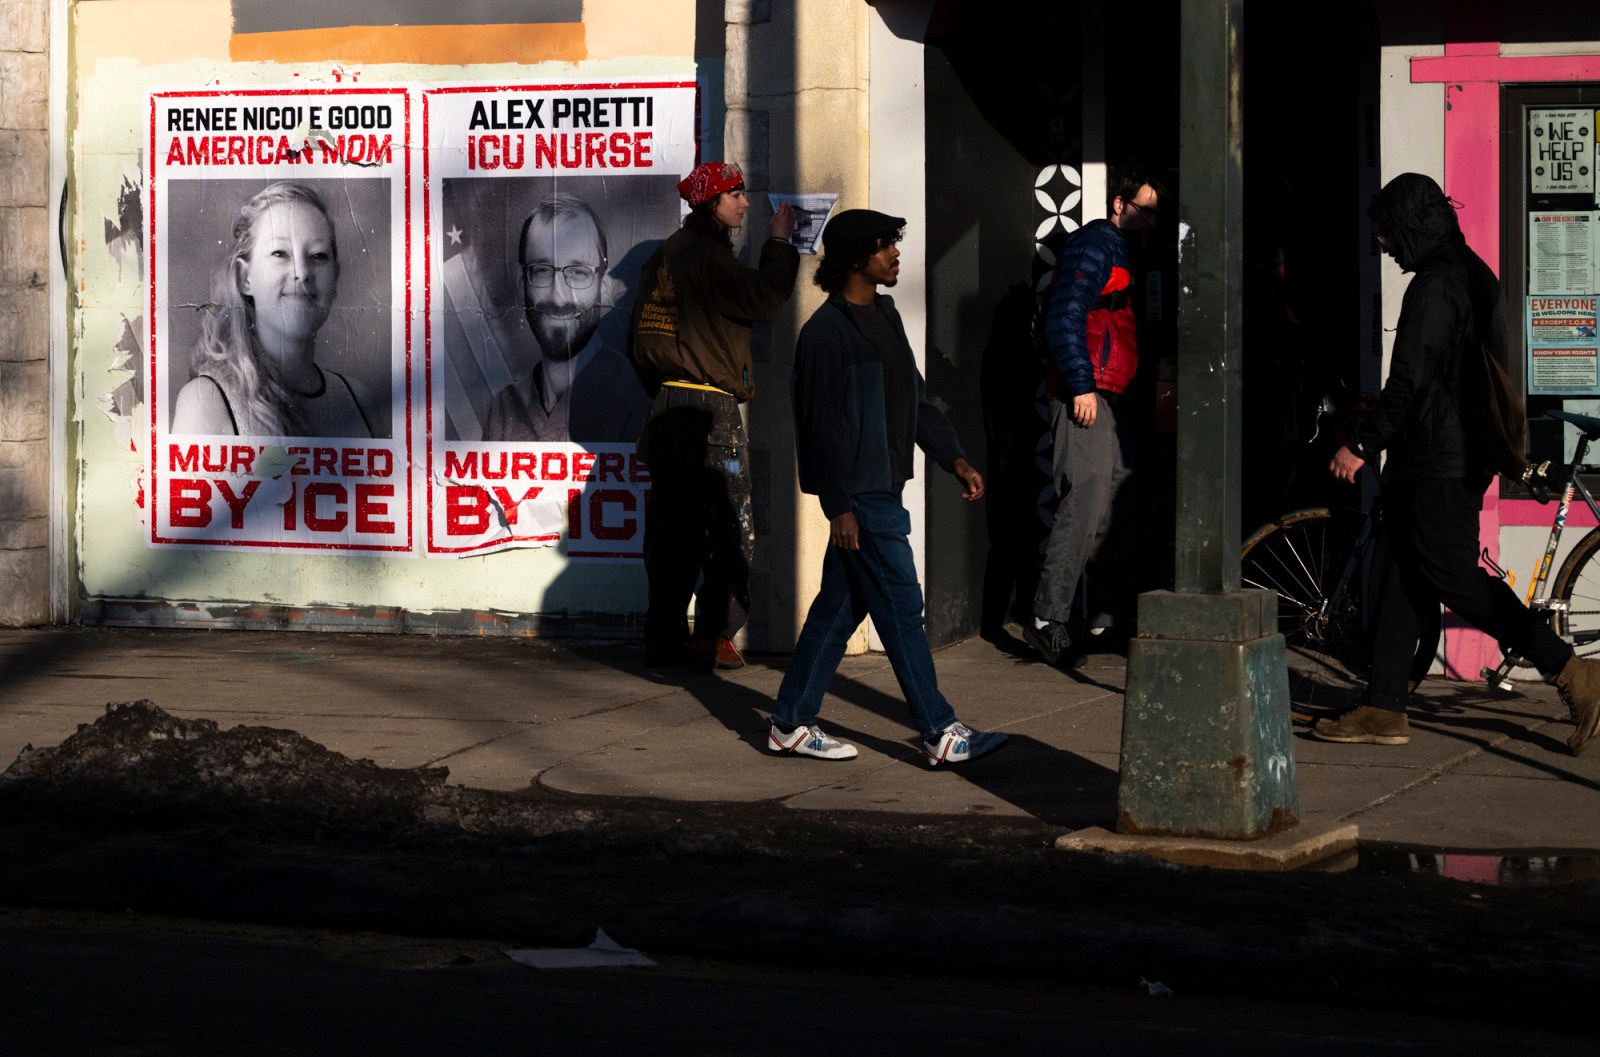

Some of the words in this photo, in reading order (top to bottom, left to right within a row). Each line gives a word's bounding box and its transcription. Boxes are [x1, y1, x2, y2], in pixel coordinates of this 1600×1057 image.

[167, 107, 237, 131] RENEE
[328, 105, 392, 130] GOOD
[469, 99, 545, 130] ALEX
[553, 96, 653, 128] PRETTI
[1549, 122, 1573, 140] WE
[166, 134, 314, 166] AMERICAN
[317, 134, 392, 165] MOM
[468, 133, 524, 170] ICU
[535, 132, 653, 169] NURSE
[1539, 142, 1583, 160] HELP
[1551, 162, 1572, 180] US
[1531, 298, 1597, 311] EVERYONE
[169, 444, 393, 478] MURERED
[444, 450, 652, 483] MURDERE
[169, 479, 261, 529] BY
[284, 482, 395, 534] ICE
[446, 485, 543, 536] BY
[567, 488, 652, 541] IC
